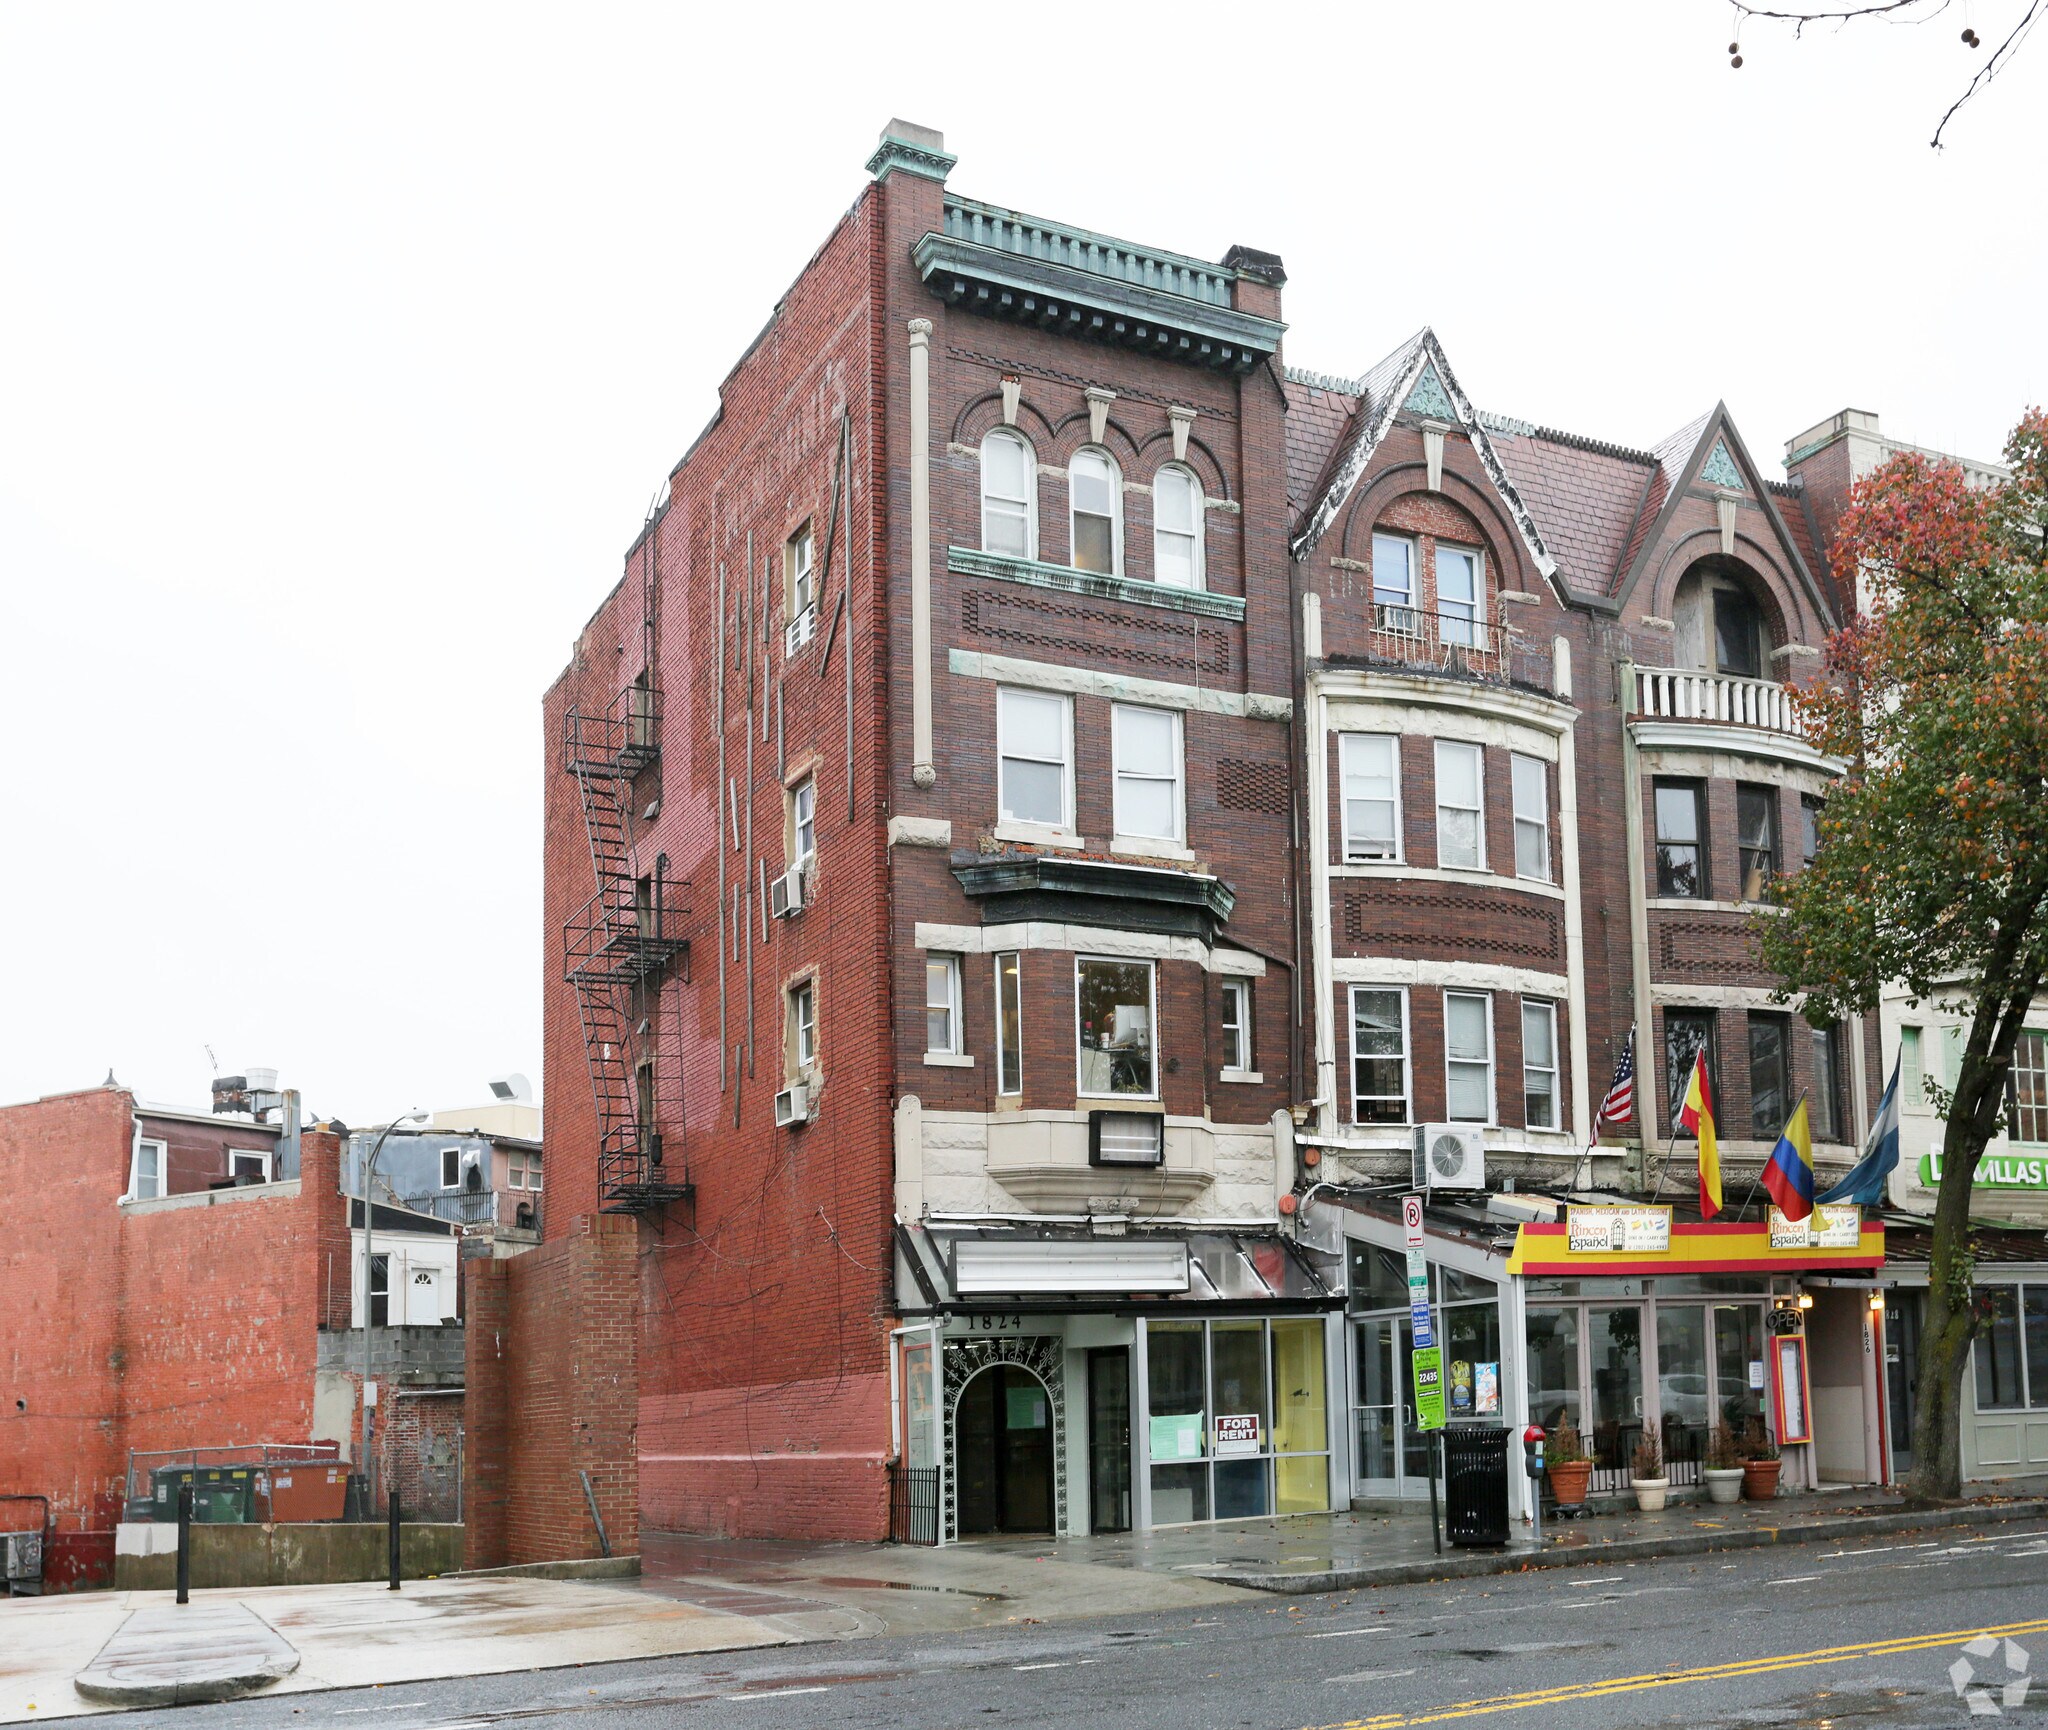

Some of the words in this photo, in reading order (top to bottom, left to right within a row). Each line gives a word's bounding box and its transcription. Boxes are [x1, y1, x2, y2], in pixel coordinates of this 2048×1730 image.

[1596, 1208, 1620, 1216] MEXICAN
[1631, 1208, 1646, 1216] LATIN
[1569, 1235, 1608, 1250] Español
[1770, 1232, 1806, 1247] Español
[969, 1314, 1021, 1330] 1824
[1767, 1311, 1803, 1329] OPEN
[1863, 1323, 1871, 1353] 1826
[1418, 1371, 1438, 1383] 22435
[1223, 1418, 1251, 1430] FOR
[1219, 1428, 1256, 1441] RENT
